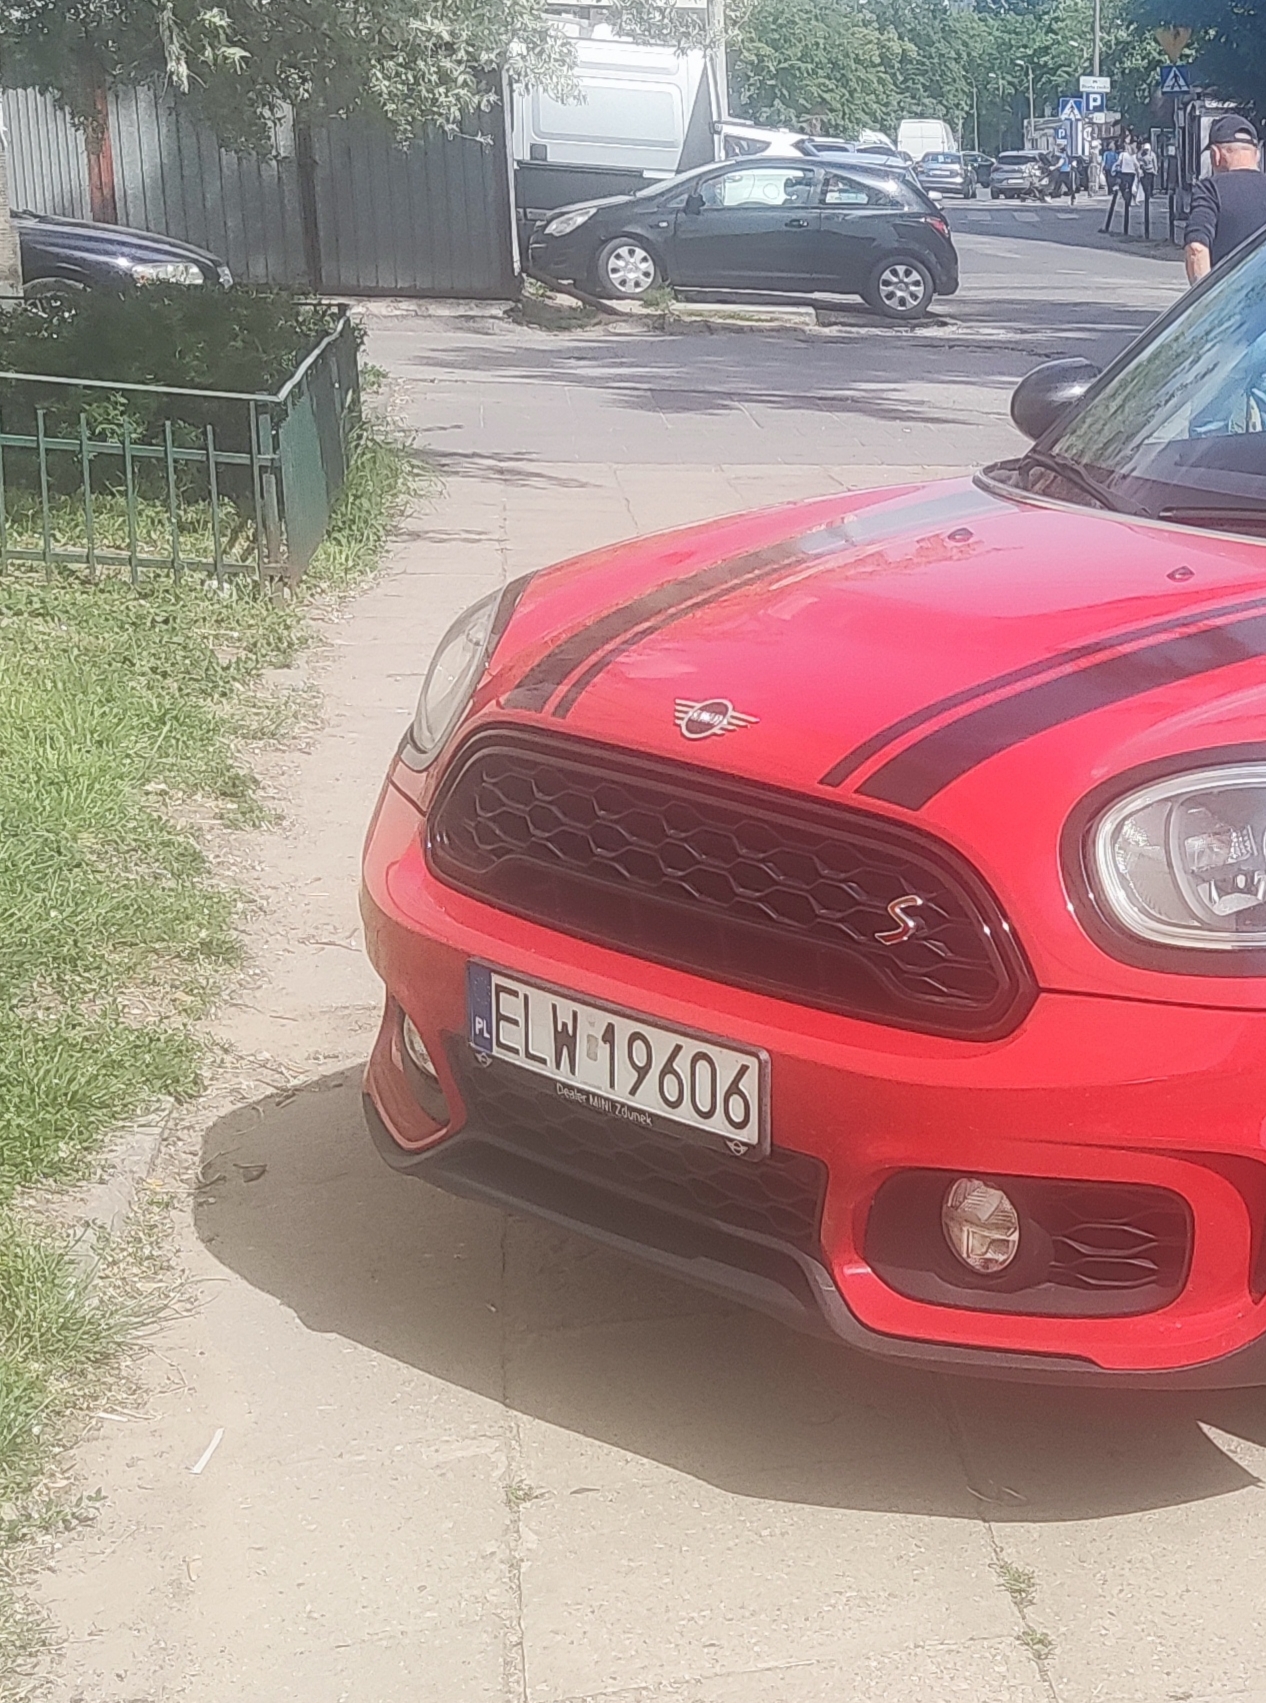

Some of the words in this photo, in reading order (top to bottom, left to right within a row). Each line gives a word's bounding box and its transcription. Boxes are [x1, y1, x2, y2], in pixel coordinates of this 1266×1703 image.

[1089, 93, 1102, 110] P
[874, 894, 923, 946] S
[475, 1015, 490, 1039] PL
[494, 982, 579, 1077] ELW
[601, 1021, 751, 1131] 19606
[556, 1081, 588, 1104] Dealer
[589, 1093, 612, 1113] MINI
[615, 1102, 653, 1127] Zdunek
